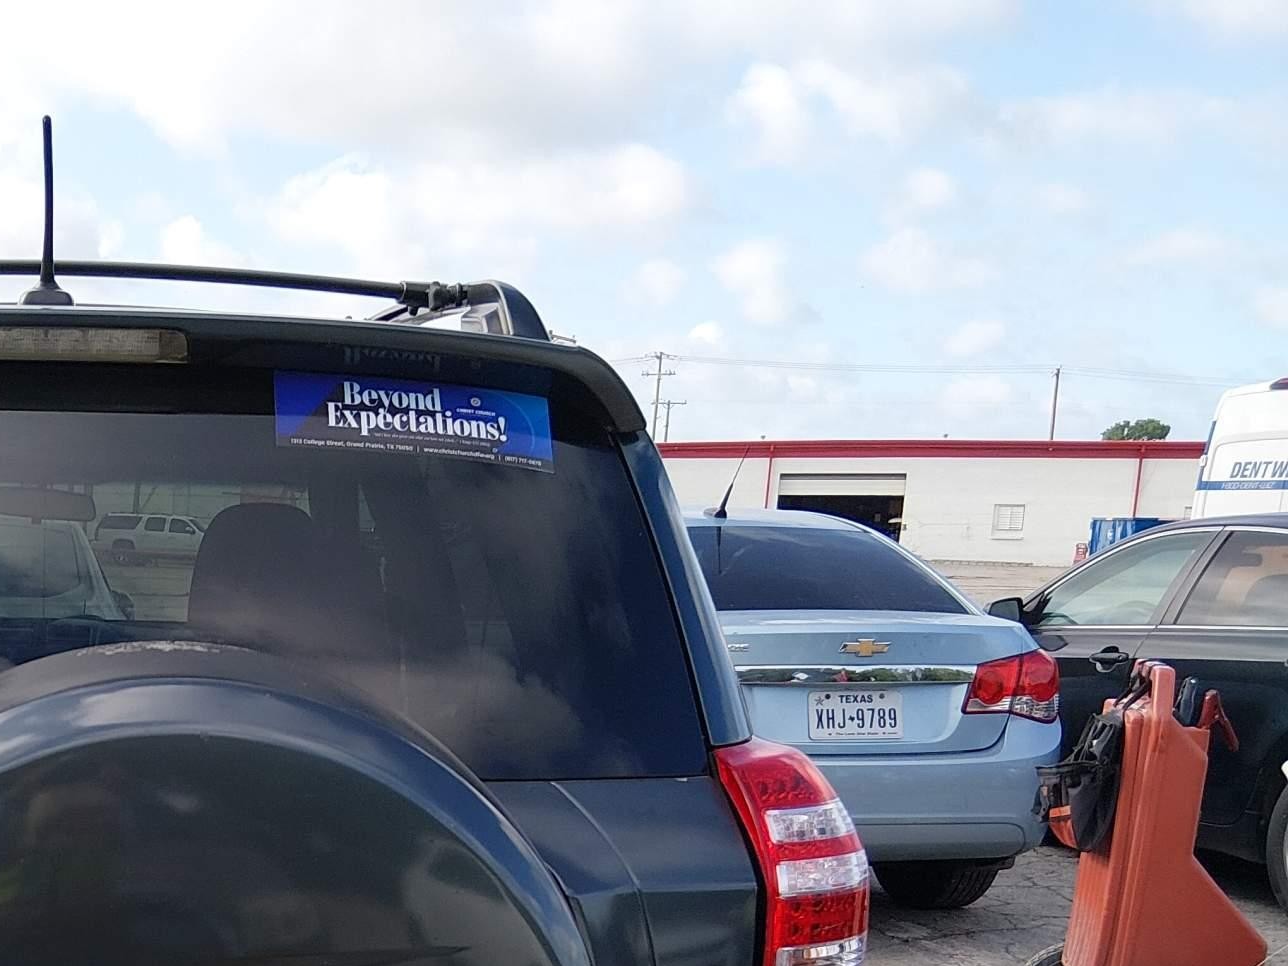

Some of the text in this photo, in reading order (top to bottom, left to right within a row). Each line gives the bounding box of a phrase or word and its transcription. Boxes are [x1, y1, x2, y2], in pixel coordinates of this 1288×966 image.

[343, 381, 442, 414] Beyond
[326, 401, 508, 442] Expectations!
[838, 694, 873, 704] TEXAS
